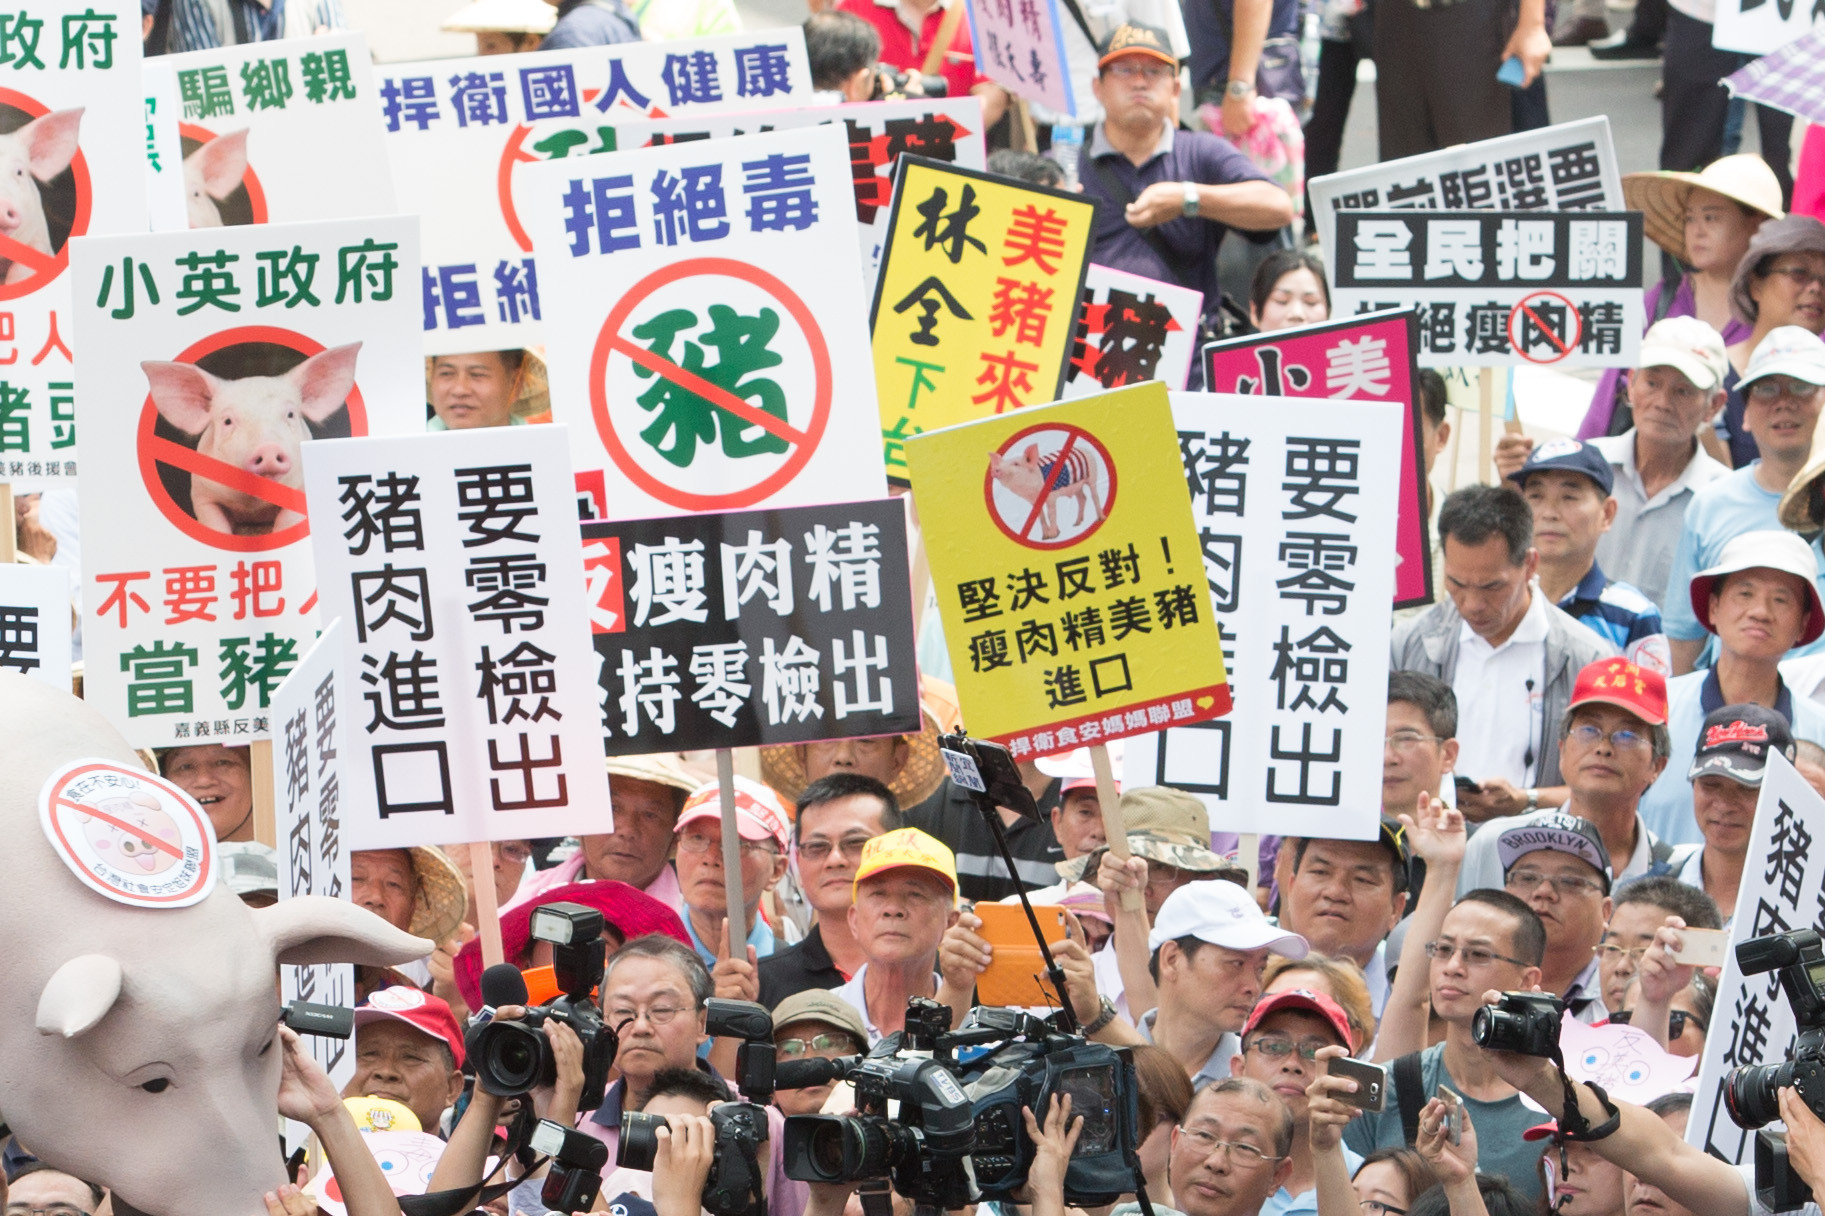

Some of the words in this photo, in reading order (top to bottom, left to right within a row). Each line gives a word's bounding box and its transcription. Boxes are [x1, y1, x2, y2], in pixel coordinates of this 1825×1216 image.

[179, 48, 358, 120] 騙鄉親
[379, 44, 794, 133] 捍衛國人健康
[562, 153, 820, 257] 拒絕毒
[96, 238, 399, 319] 小英政府
[1354, 220, 1630, 283] 全民把關
[972, 204, 1068, 414] 美豬來
[631, 304, 789, 468] 豬
[337, 471, 454, 820] 豬肉進口
[454, 463, 569, 811] 要零檢出
[968, 584, 1200, 675] 瘦肉精美豬
[1266, 436, 1361, 807] 要零檢出
[119, 630, 322, 718] 當豬
[1043, 653, 1133, 710] 進口
[1010, 697, 1196, 758] 捍衛食安媽媽聯盟
[1503, 831, 1589, 852] BROOKLYN
